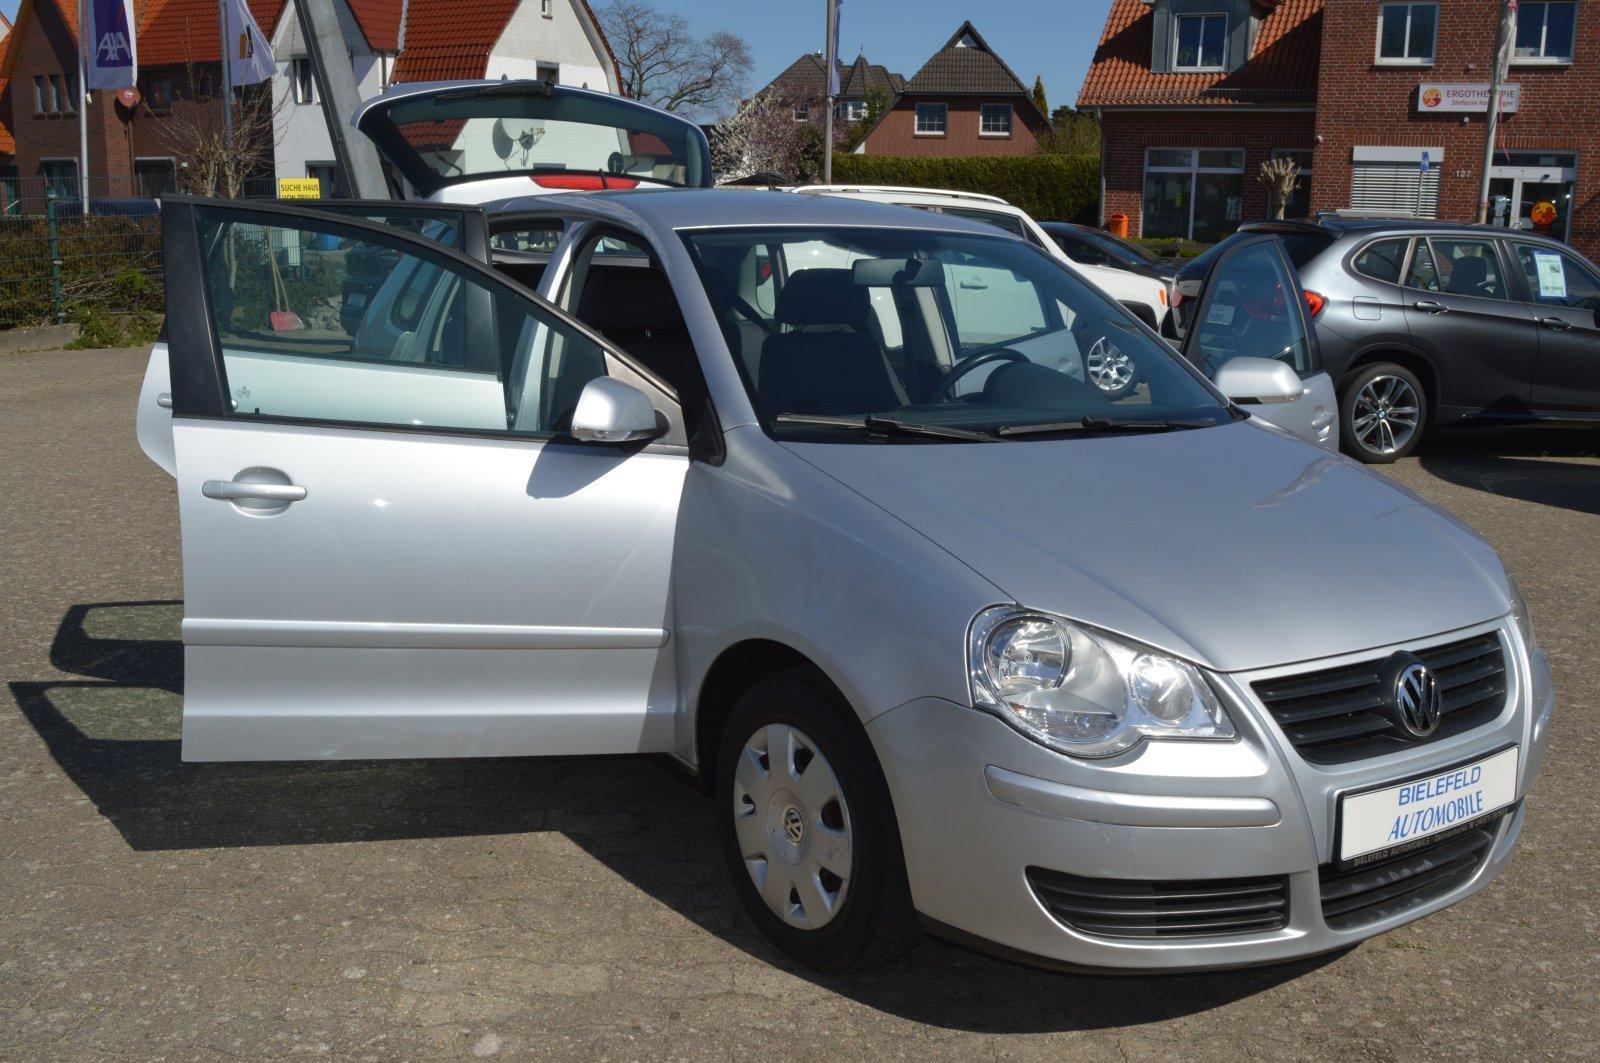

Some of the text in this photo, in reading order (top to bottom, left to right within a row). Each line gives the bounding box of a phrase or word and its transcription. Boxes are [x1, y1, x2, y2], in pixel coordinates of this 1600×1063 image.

[96, 31, 131, 61] AXA
[1446, 90, 1515, 98] ERGOTHEPIE
[1456, 170, 1472, 178] 127
[1398, 766, 1481, 806] BIELEFELD
[1387, 790, 1483, 842] AUTOMOBILE
